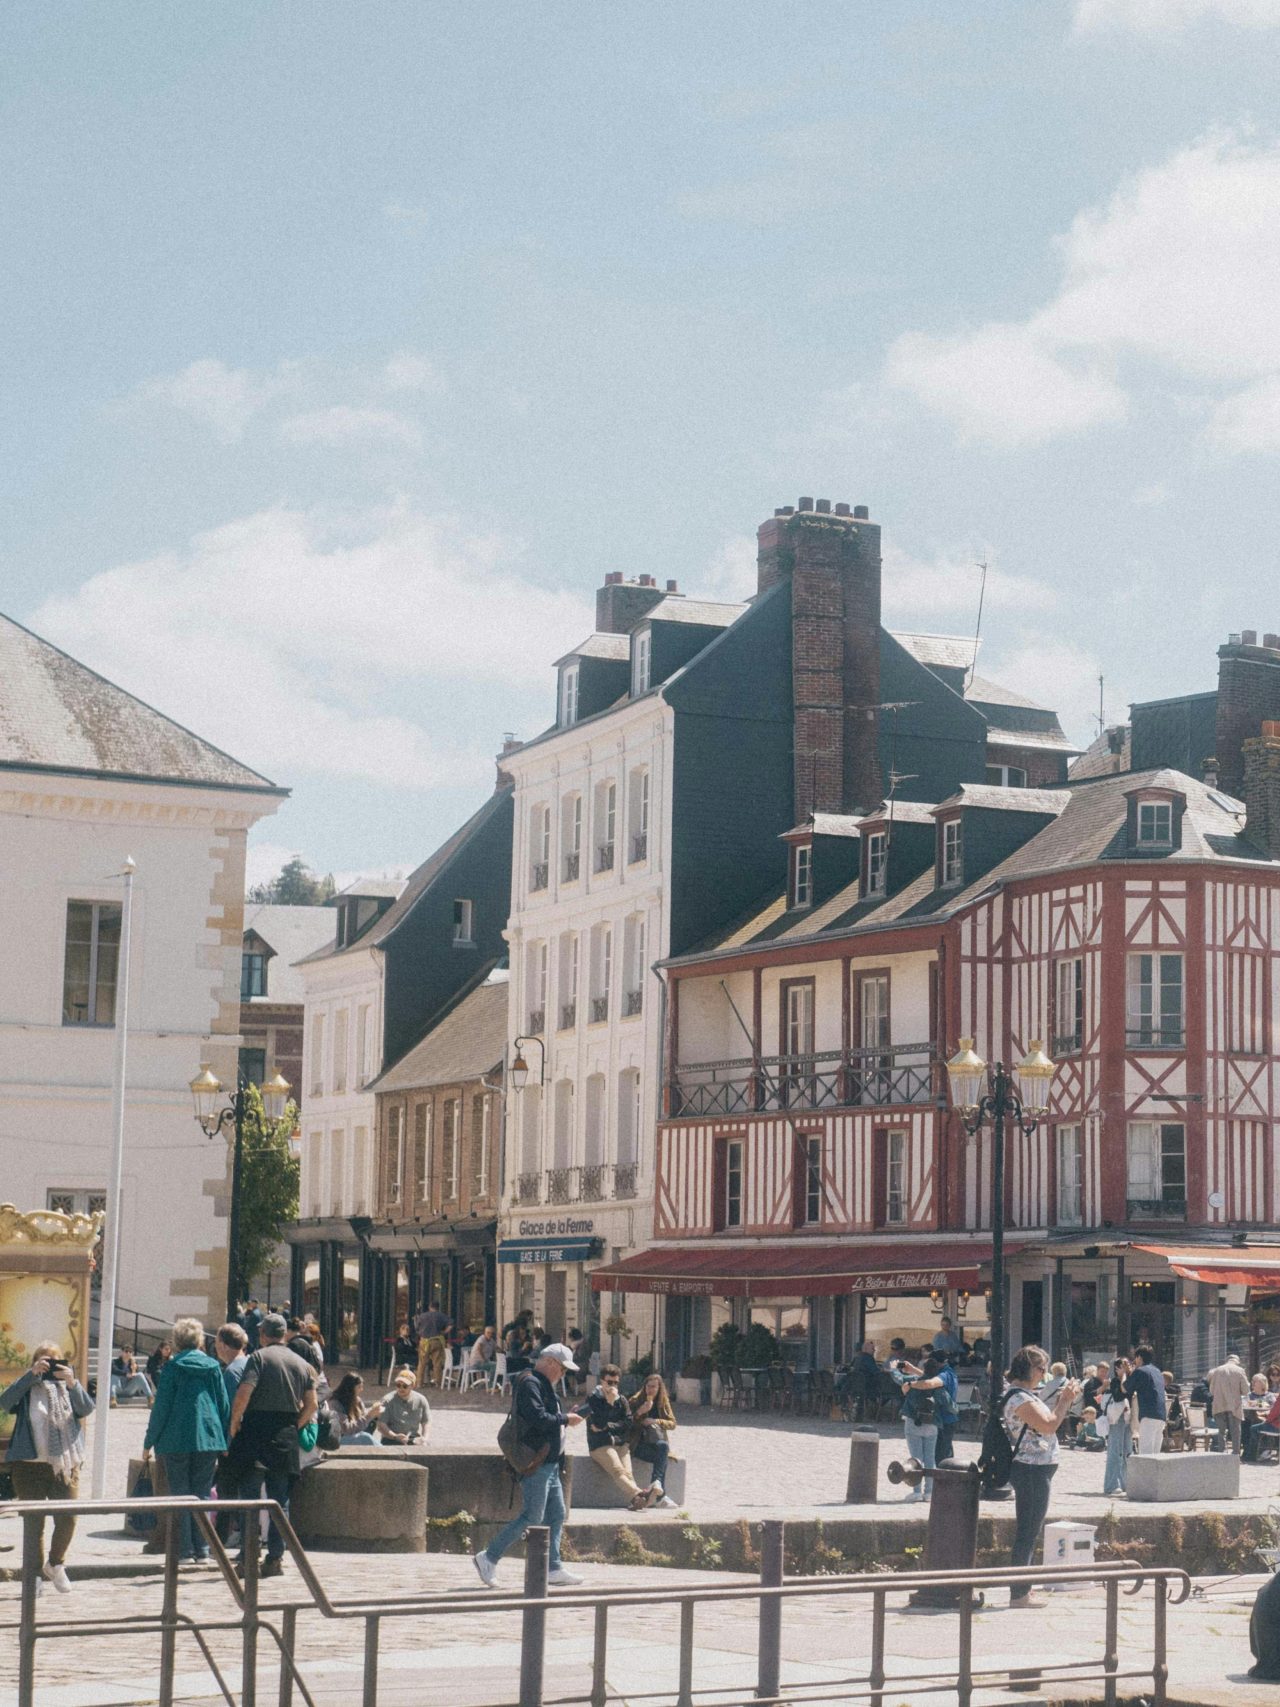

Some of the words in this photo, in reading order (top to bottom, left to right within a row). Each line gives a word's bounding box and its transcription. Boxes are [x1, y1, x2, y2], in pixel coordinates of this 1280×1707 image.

[519, 1220, 544, 1236] Glace
[546, 1219, 557, 1235] de
[558, 1219, 566, 1234] la
[567, 1217, 593, 1234] Ferme
[930, 1272, 948, 1285] Ville
[649, 1281, 670, 1292] VENTE
